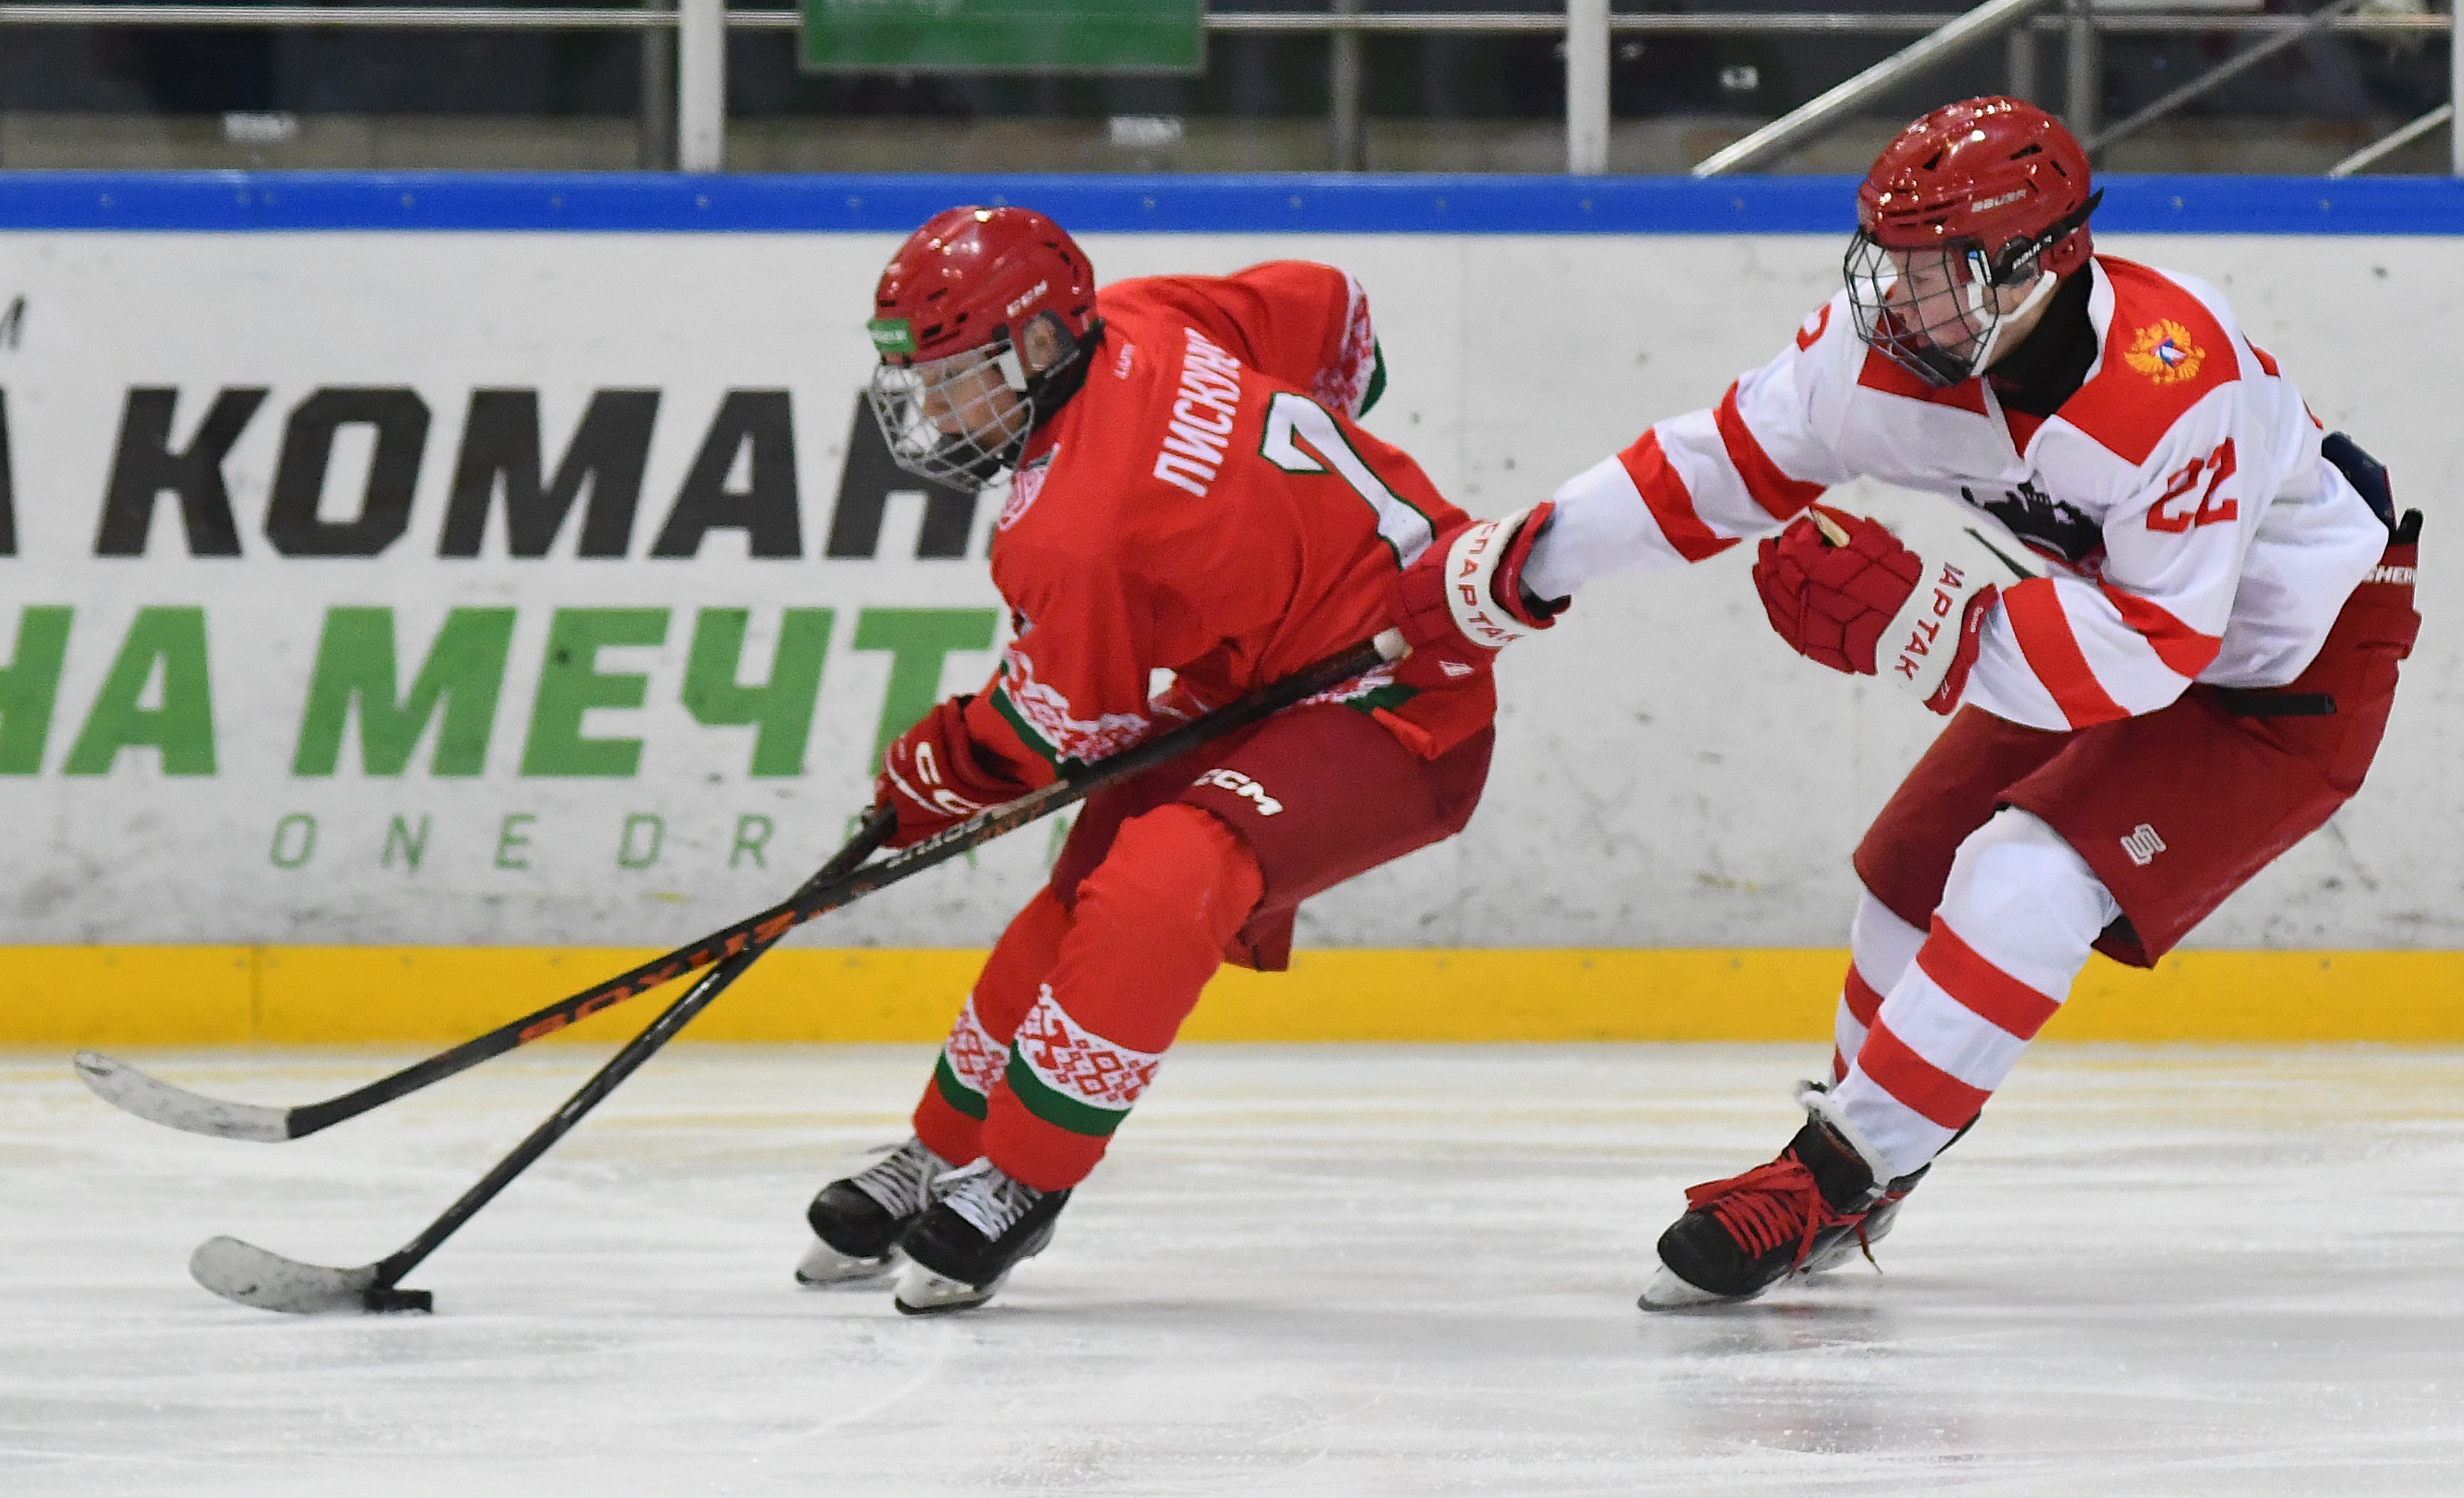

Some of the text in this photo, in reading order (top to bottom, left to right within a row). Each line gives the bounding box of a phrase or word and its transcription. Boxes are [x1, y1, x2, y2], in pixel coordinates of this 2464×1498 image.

[94, 385, 978, 558] КОМАН
[2145, 436, 2239, 534] 22
[1894, 562, 1965, 681] АРТАК
[290, 605, 999, 778] МЕЧТ
[1192, 768, 1284, 816] CCM
